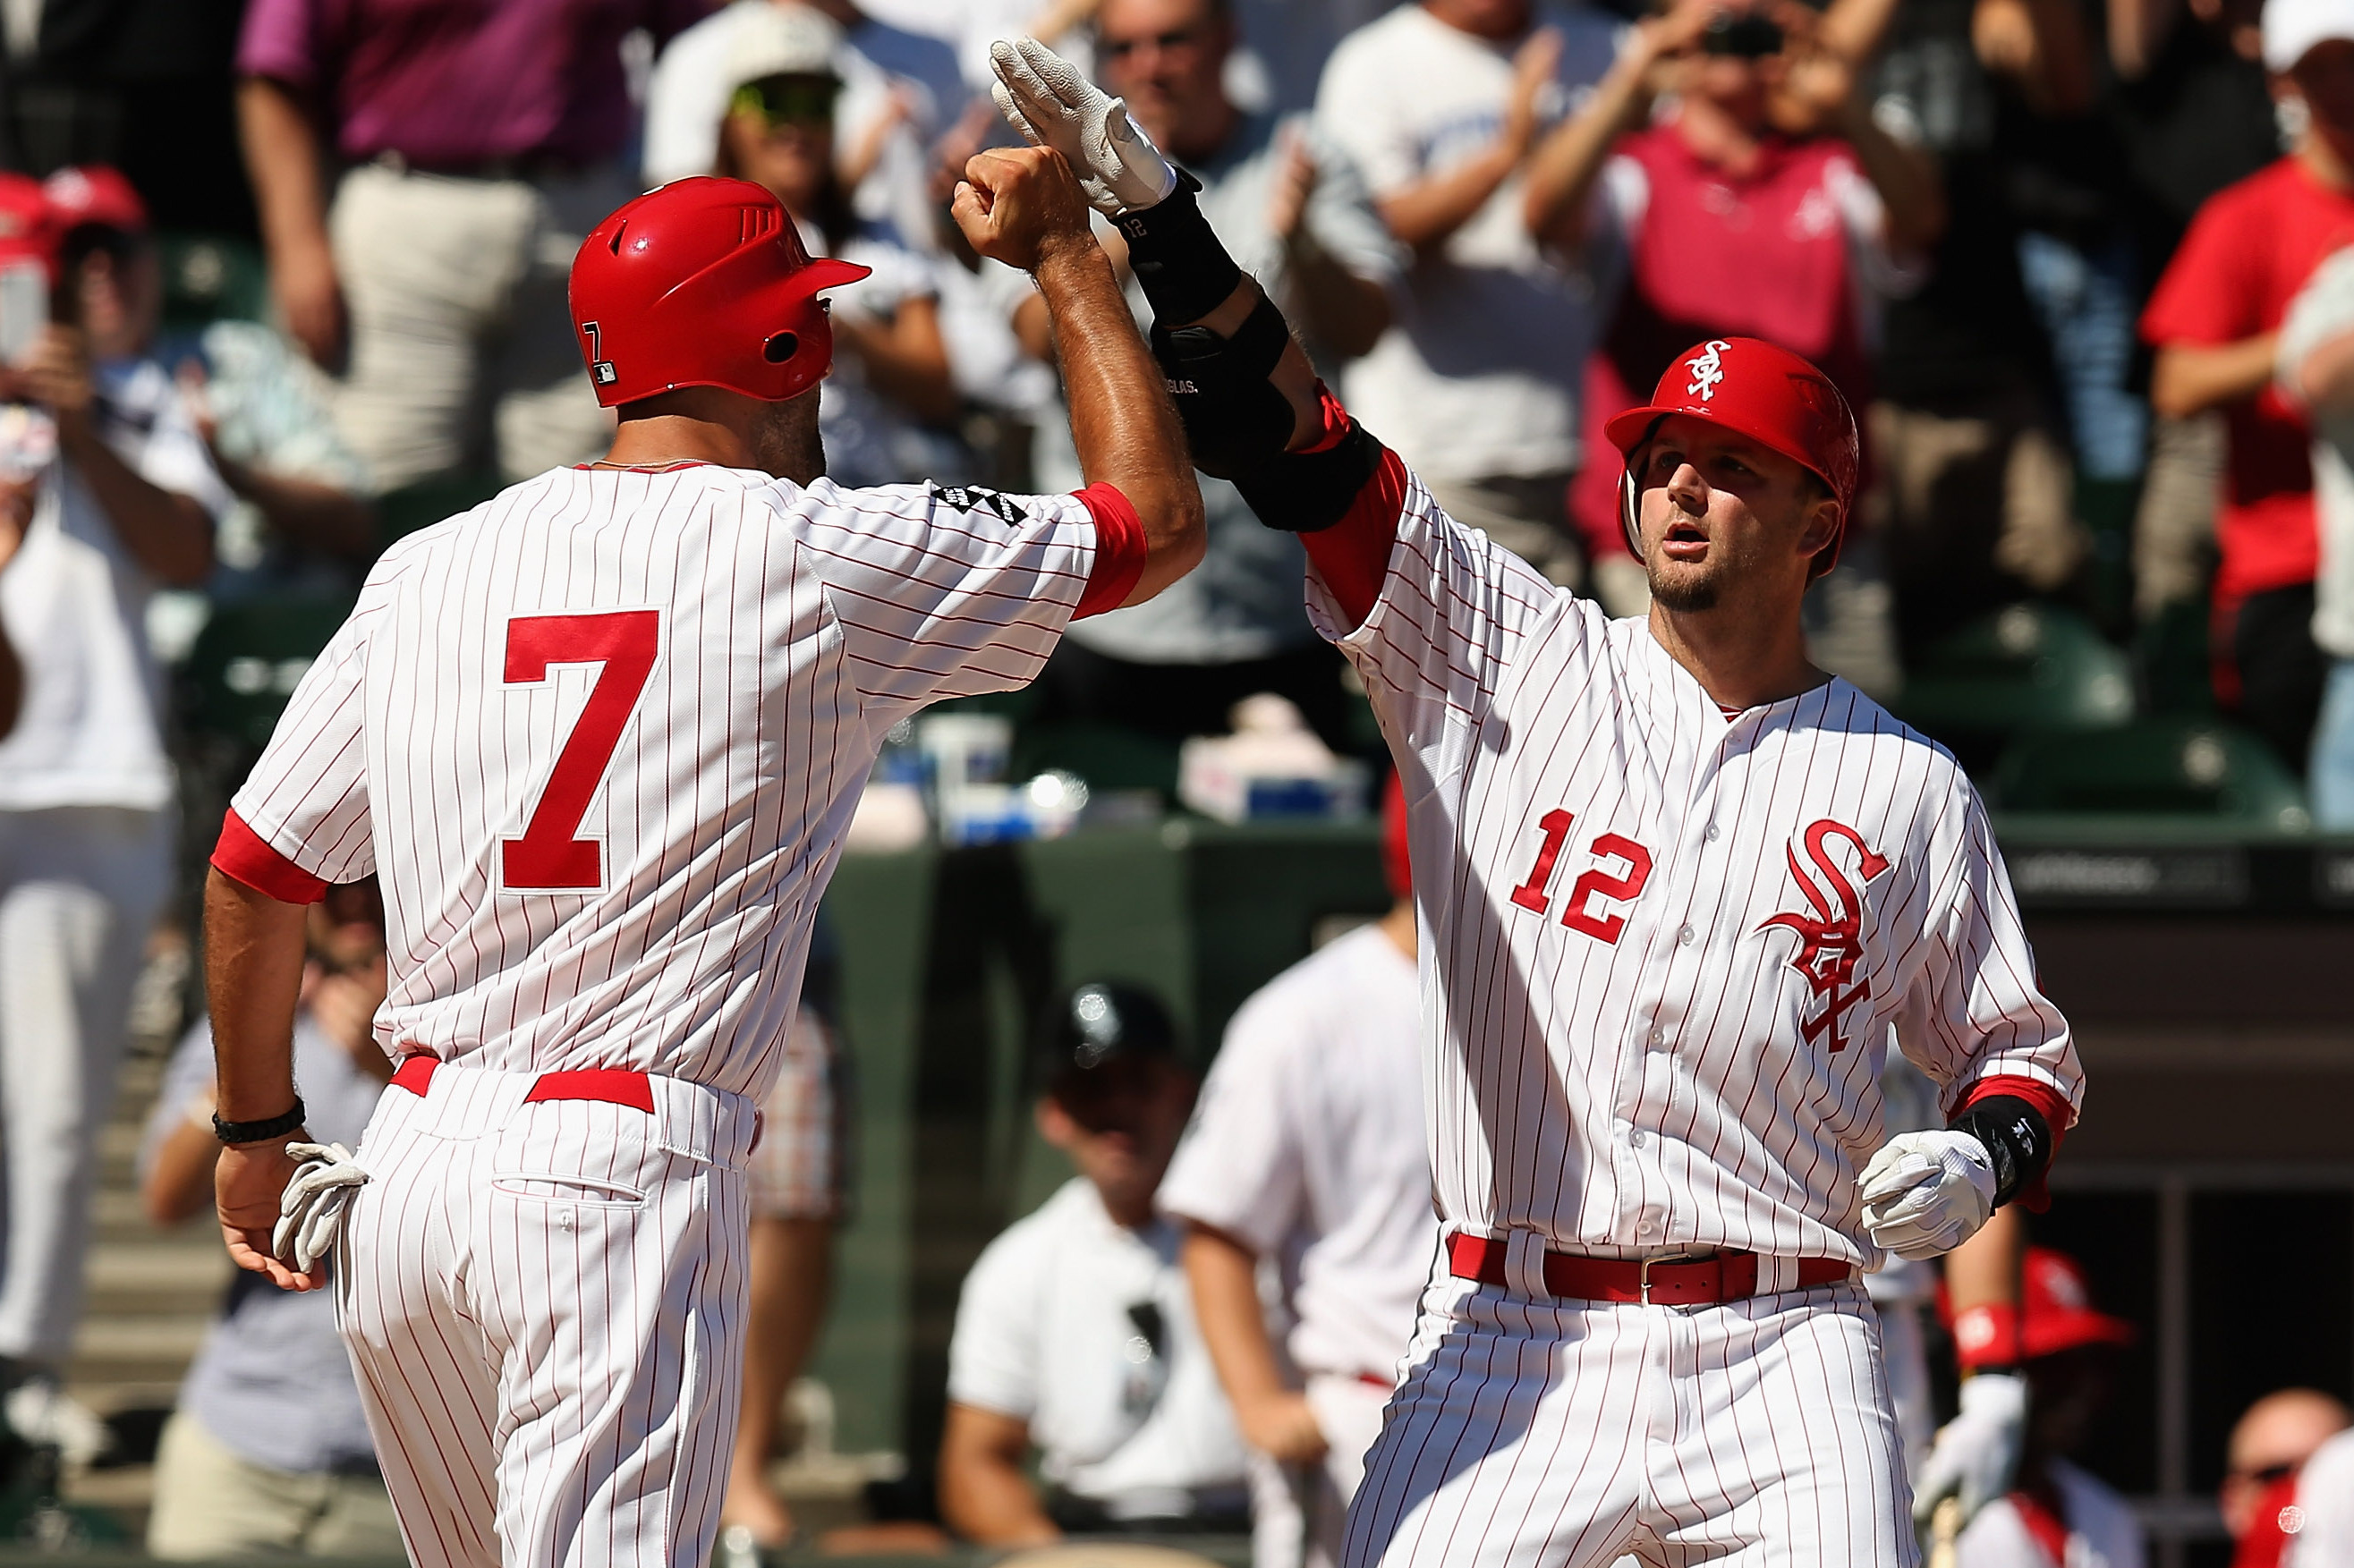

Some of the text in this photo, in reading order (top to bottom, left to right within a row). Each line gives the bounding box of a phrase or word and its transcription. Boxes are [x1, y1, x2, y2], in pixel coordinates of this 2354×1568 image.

[1124, 218, 1147, 238] 12
[582, 321, 601, 363] 7
[501, 609, 661, 890] 7
[1507, 806, 1656, 949] 12
